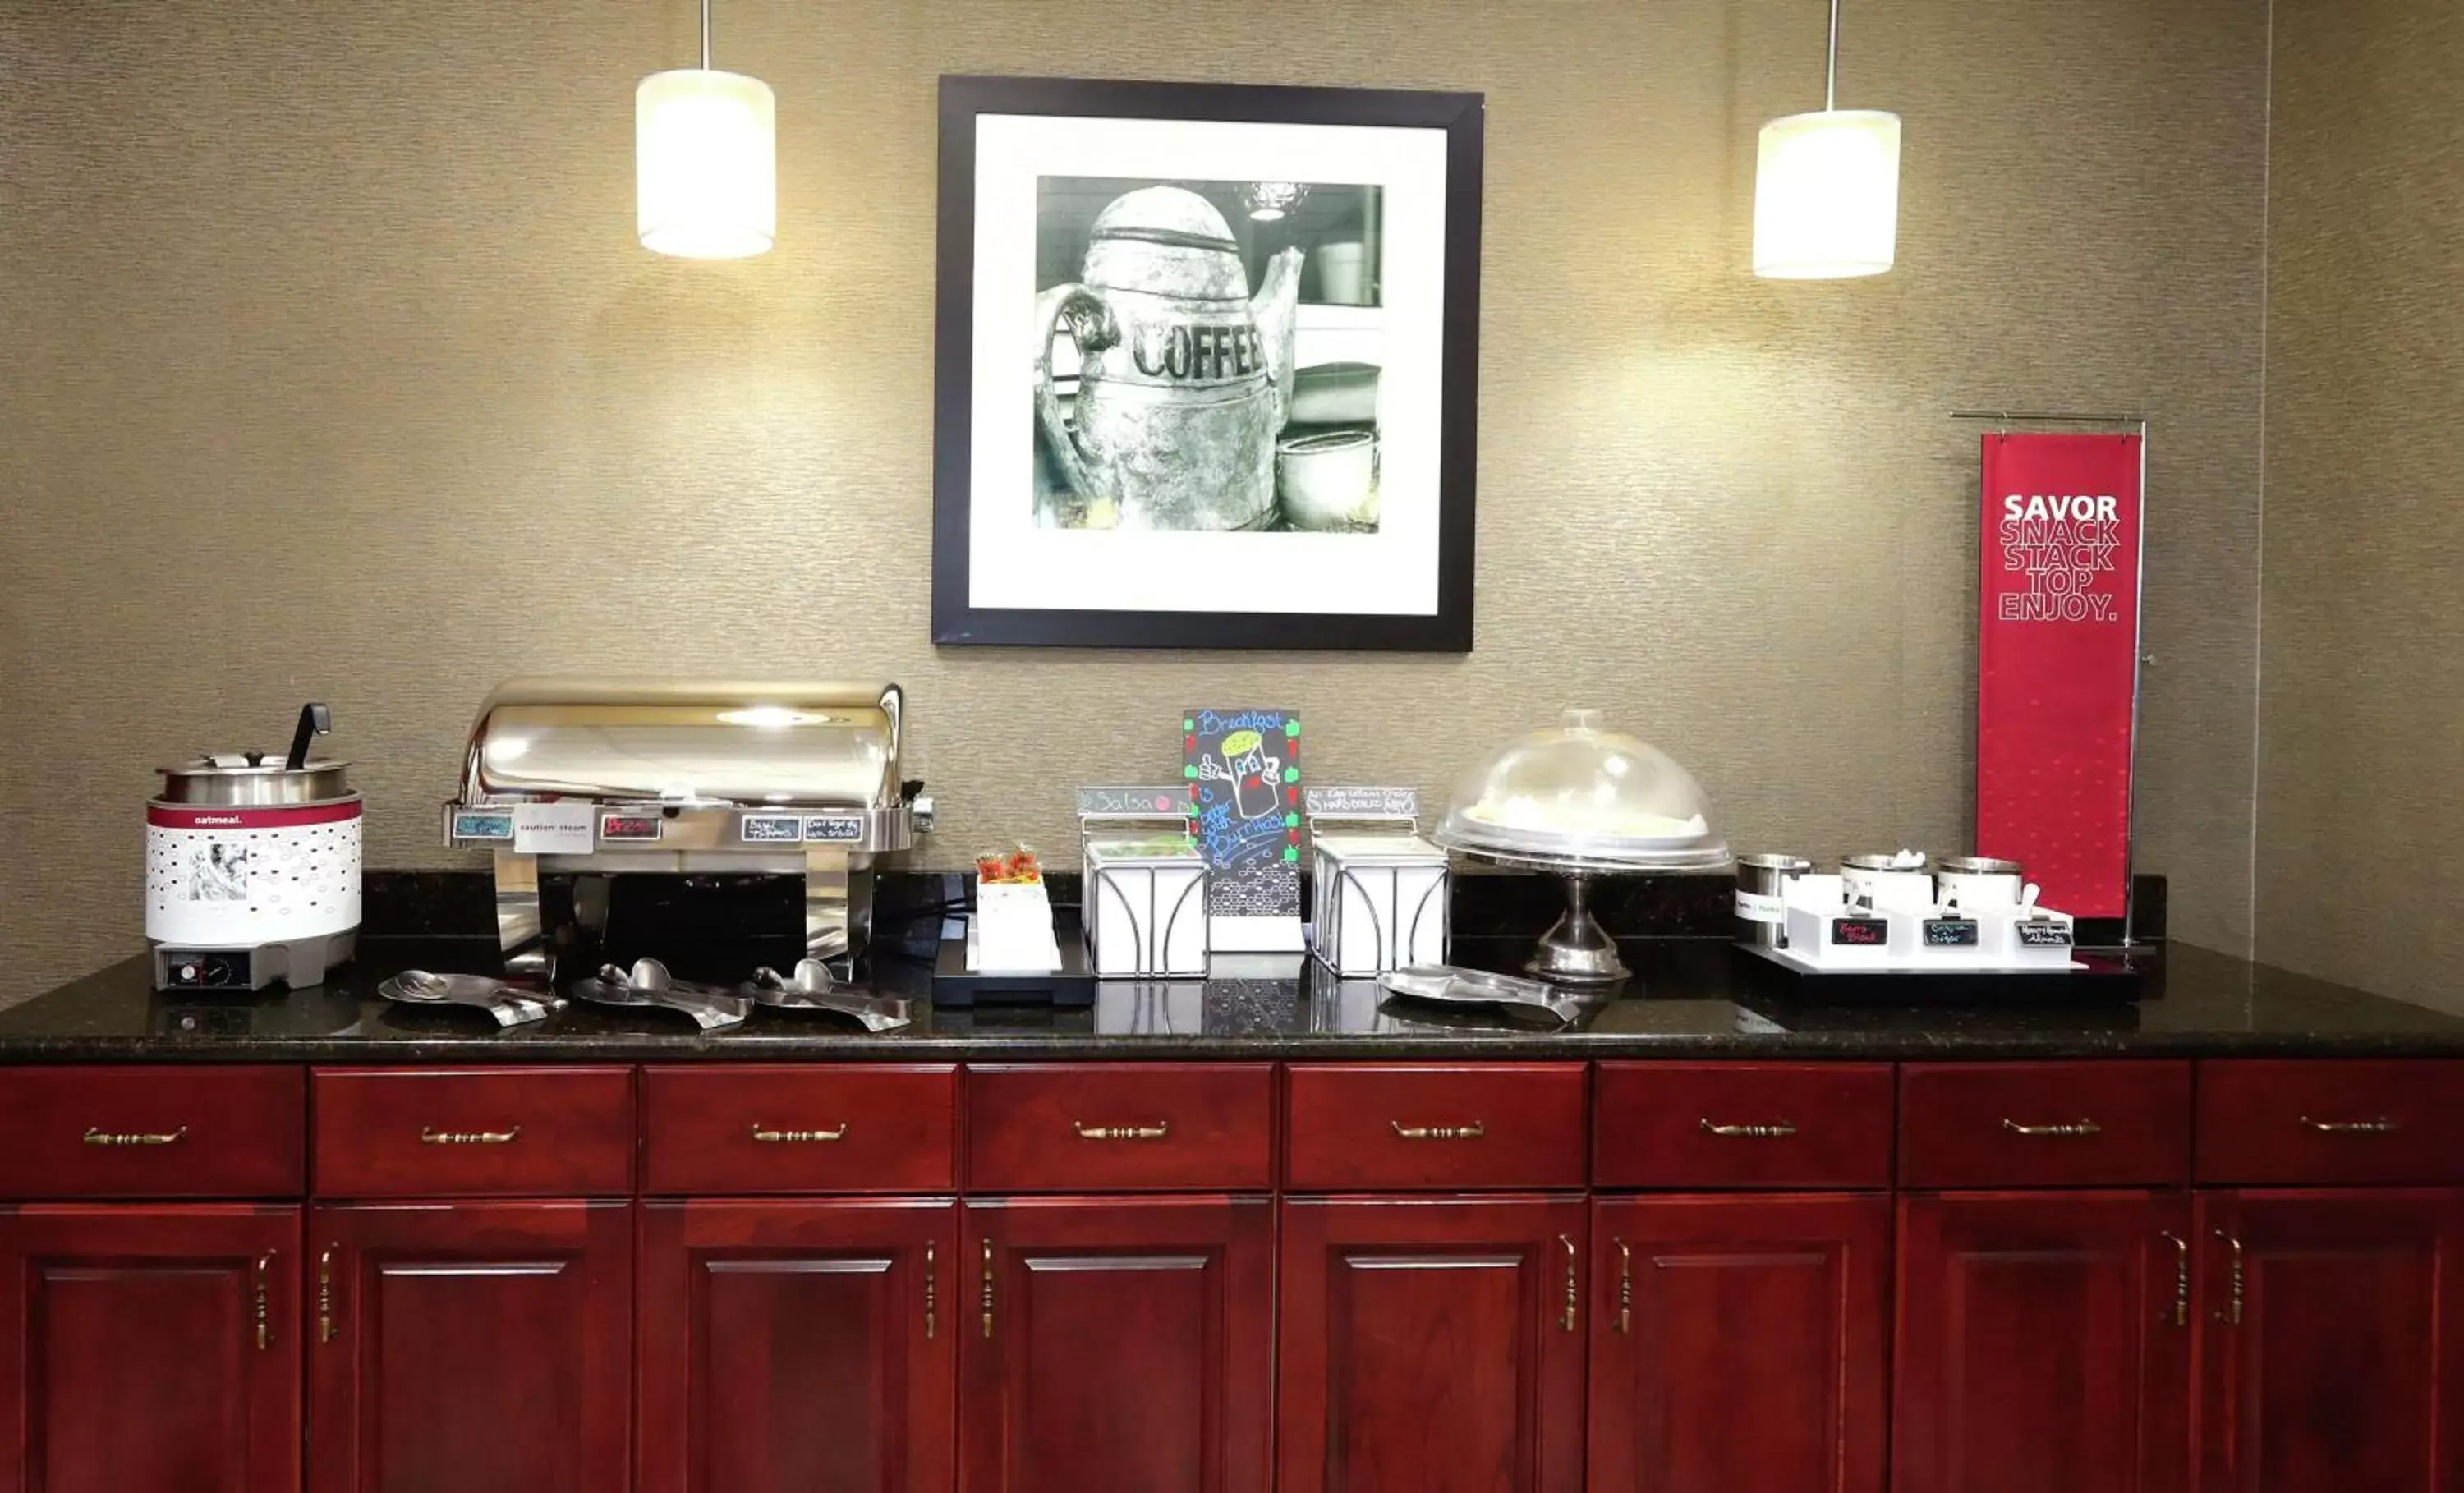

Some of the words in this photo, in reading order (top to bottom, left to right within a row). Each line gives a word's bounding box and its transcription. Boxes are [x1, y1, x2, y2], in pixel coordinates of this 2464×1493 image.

[1133, 324, 1263, 379] COFFEE
[2004, 494, 2117, 521] SAVOR
[2000, 518, 2120, 545] SNACK
[2004, 544, 2114, 571] STACK
[2026, 569, 2094, 595] TOP
[1998, 592, 2118, 621] ENJOY.
[1198, 709, 1285, 736] Breakfast
[1095, 791, 1152, 811] Salsa
[194, 815, 243, 825] oatmeal.
